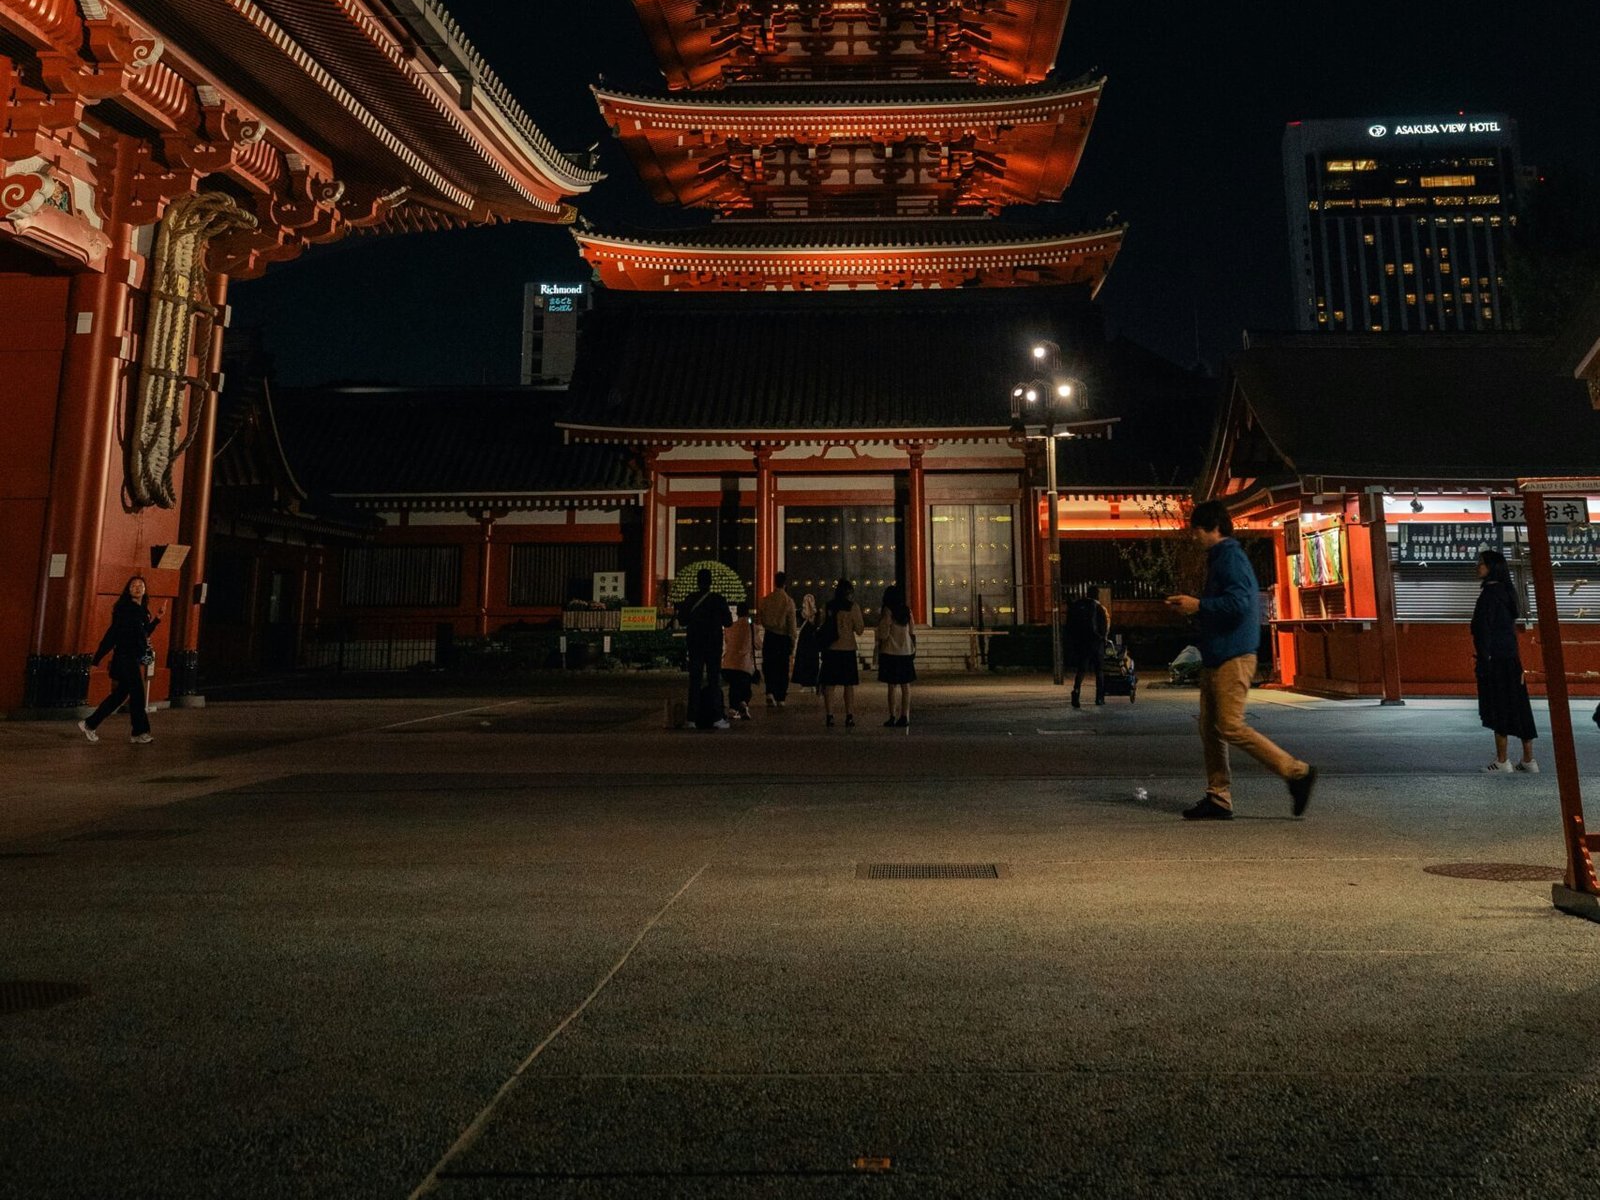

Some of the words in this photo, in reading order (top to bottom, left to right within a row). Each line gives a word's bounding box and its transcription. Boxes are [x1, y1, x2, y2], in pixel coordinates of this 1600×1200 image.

[1395, 125, 1439, 136] ASAKUSA
[1440, 123, 1467, 134] VIEW
[1470, 122, 1501, 133] HOTEL
[541, 284, 582, 295] Richmond
